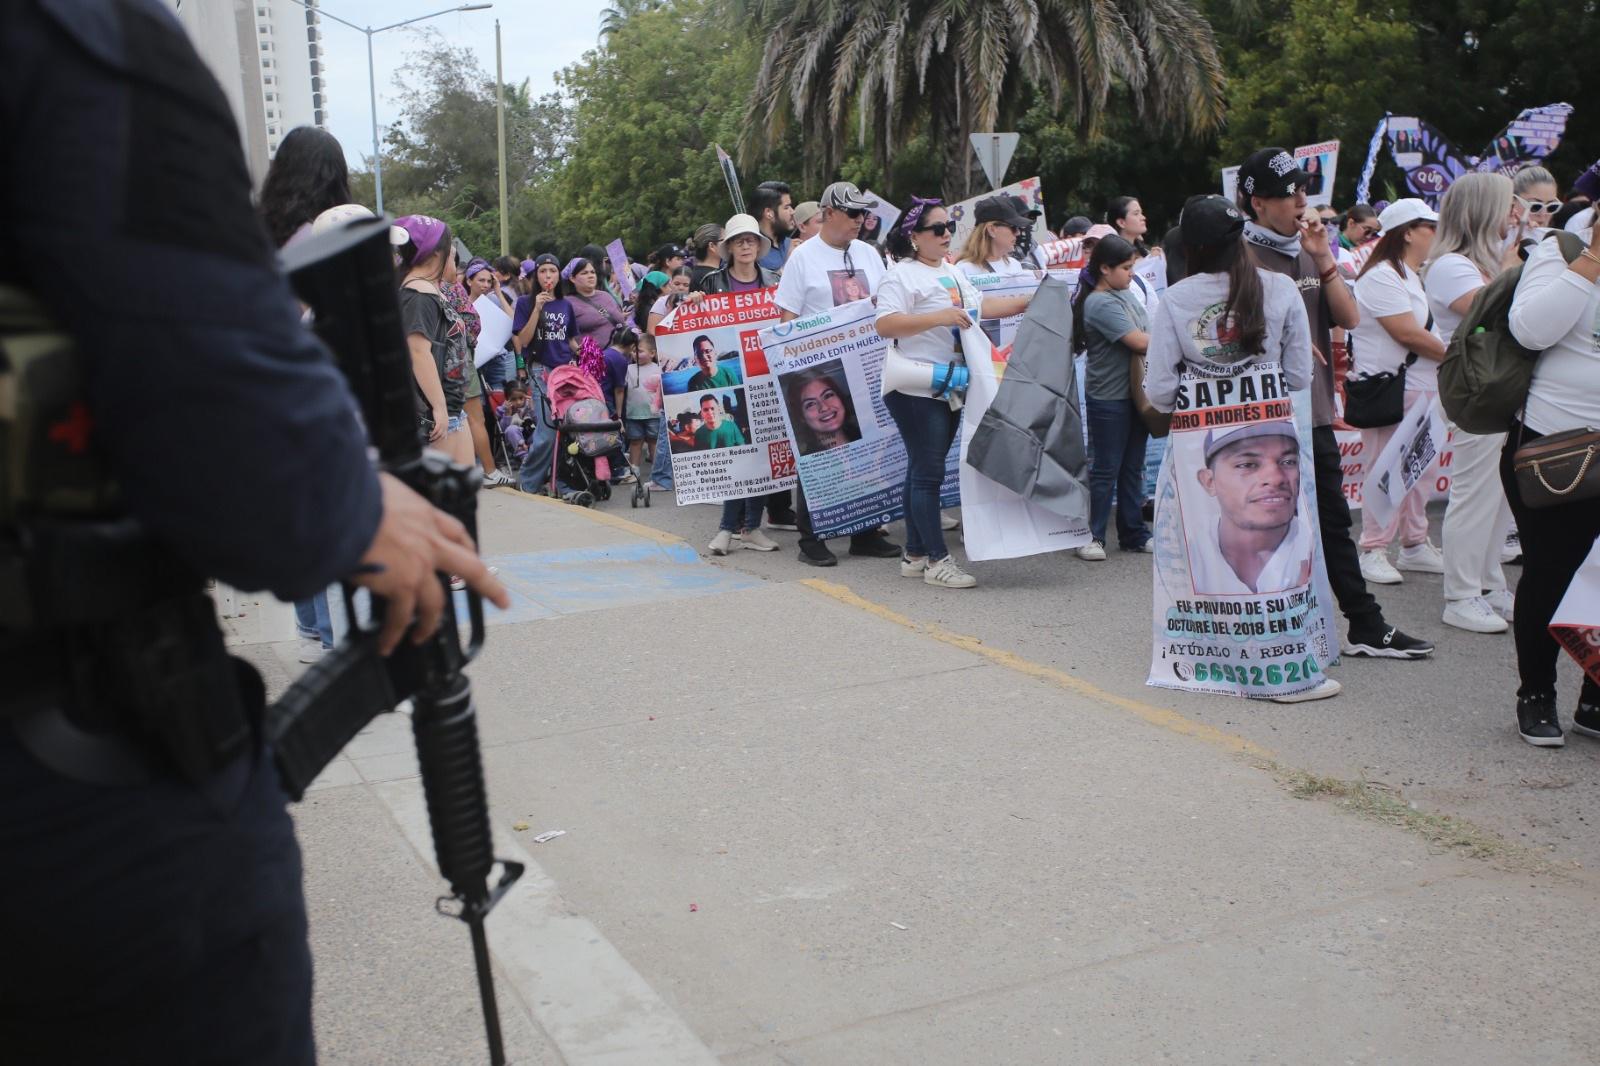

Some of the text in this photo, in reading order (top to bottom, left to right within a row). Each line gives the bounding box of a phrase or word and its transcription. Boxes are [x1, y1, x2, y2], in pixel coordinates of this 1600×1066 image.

[970, 275, 1001, 286] Sinaloa
[735, 288, 779, 308] ESTÁ
[682, 313, 735, 330] ESTAMOS
[795, 313, 832, 331] Sinaloa
[783, 322, 877, 358] Ayúdanos a en
[788, 351, 827, 370] SANDRA
[828, 342, 856, 358] EDITH
[856, 334, 884, 349] HUER
[750, 391, 768, 400] Fecha
[1171, 413, 1200, 430] DRO
[1204, 403, 1261, 426] ANDRÉS
[729, 446, 759, 456] Redonda
[709, 458, 734, 467] oscuro
[695, 467, 727, 477] Pobladas
[700, 475, 732, 484] Delgados
[812, 512, 821, 520] Si
[822, 507, 845, 518] tienes
[814, 519, 834, 528] llama
[882, 498, 891, 507] Tu
[1176, 600, 1193, 614] FUE
[1195, 599, 1242, 615] PRIVADO
[1245, 600, 1263, 615] DE
[1266, 598, 1284, 614] SU
[1167, 618, 1211, 634] OCTUBRE
[1212, 619, 1231, 635] DEL
[1233, 617, 1266, 636] 2018
[1269, 618, 1288, 634] EN
[1161, 641, 1231, 659] ¡AYÚDALO
[1239, 649, 1250, 659] A
